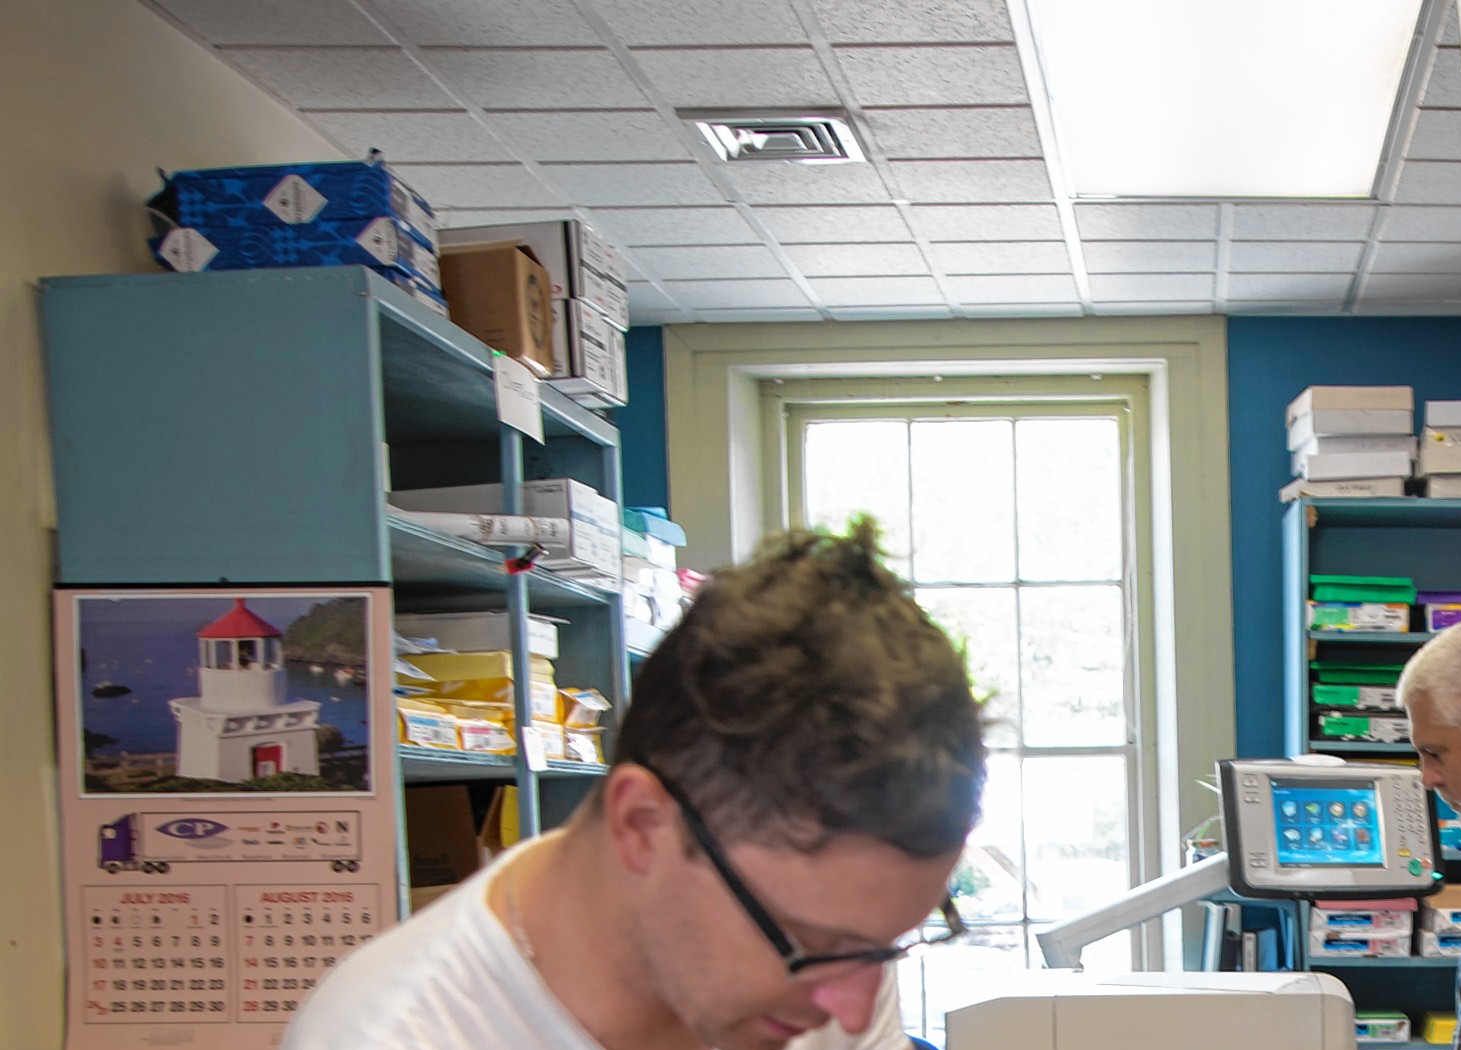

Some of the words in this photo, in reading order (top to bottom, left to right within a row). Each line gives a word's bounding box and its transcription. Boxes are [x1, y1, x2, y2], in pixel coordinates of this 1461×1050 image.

[168, 822, 214, 837] CP
[120, 893, 154, 904] JULY
[157, 892, 190, 904] 2016
[260, 891, 319, 903] AUGUST
[321, 891, 354, 903] 2016
[190, 914, 199, 925] 1
[209, 914, 220, 925] 2
[264, 913, 273, 925] 1
[283, 913, 294, 925] 2
[302, 913, 313, 925] 3
[321, 913, 332, 925] 4
[341, 913, 352, 925] 5
[360, 913, 371, 925] 6
[93, 936, 104, 948] 3
[112, 936, 123, 948] 4
[132, 936, 143, 948] 5
[151, 936, 162, 948] 6
[170, 936, 181, 948] 7
[190, 936, 201, 948] 8
[209, 936, 220, 948] 9
[245, 935, 255, 946] 7
[264, 935, 275, 946] 8
[283, 935, 294, 946] 9
[301, 935, 317, 946] 10
[321, 935, 336, 946] 11
[340, 935, 356, 946] 12
[93, 957, 108, 969] 10
[112, 957, 127, 969] 11
[131, 957, 147, 969] 12
[150, 957, 166, 969] 13
[169, 957, 185, 969] 14
[189, 957, 205, 969] 15
[208, 957, 225, 969] 16
[244, 956, 259, 968] 14
[263, 956, 280, 968] 15
[282, 956, 298, 968] 16
[302, 956, 316, 968] 17
[93, 979, 108, 991] 17
[112, 979, 127, 991] 18
[131, 979, 147, 991] 19
[150, 979, 166, 991] 20
[169, 979, 185, 991] 21
[189, 979, 205, 991] 22
[208, 979, 225, 991] 23
[243, 978, 259, 990] 21
[262, 978, 278, 990] 22
[282, 978, 298, 990] 23
[112, 1001, 127, 1013] 25
[131, 1001, 147, 1013] 26
[150, 1001, 166, 1013] 27
[169, 1001, 185, 1013] 28
[189, 1001, 205, 1013] 29
[208, 1001, 225, 1013] 30
[243, 1000, 259, 1012] 28
[262, 1000, 278, 1012] 29
[281, 1000, 297, 1012] 30
